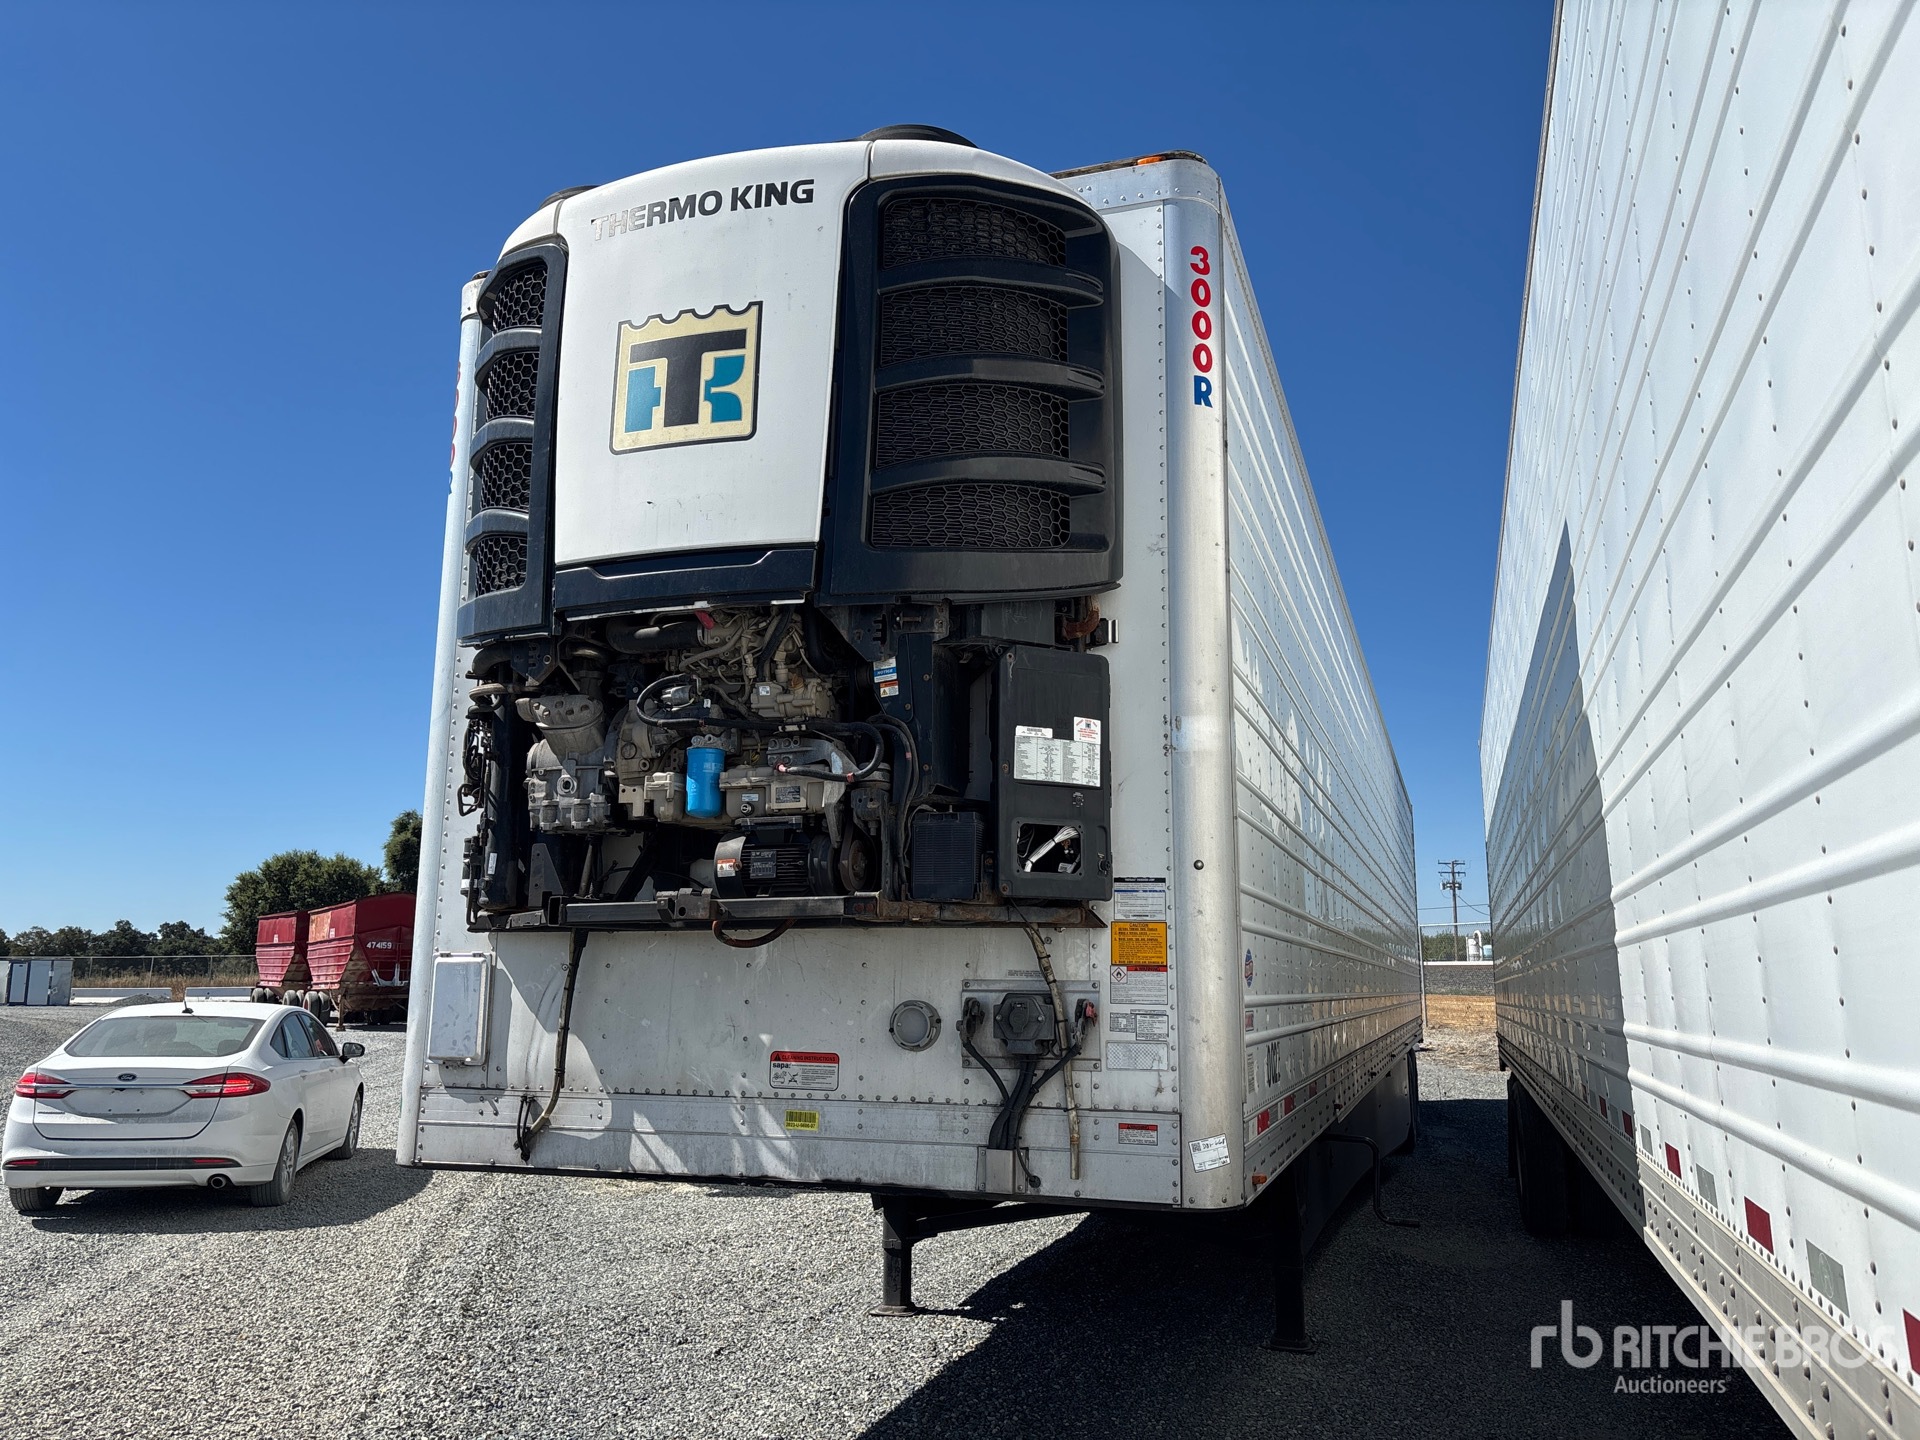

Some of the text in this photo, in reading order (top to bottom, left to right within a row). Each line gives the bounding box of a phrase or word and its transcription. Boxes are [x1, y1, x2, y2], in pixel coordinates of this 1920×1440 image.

[590, 179, 815, 241] THERMO KING
[366, 941, 392, 949] 474159
